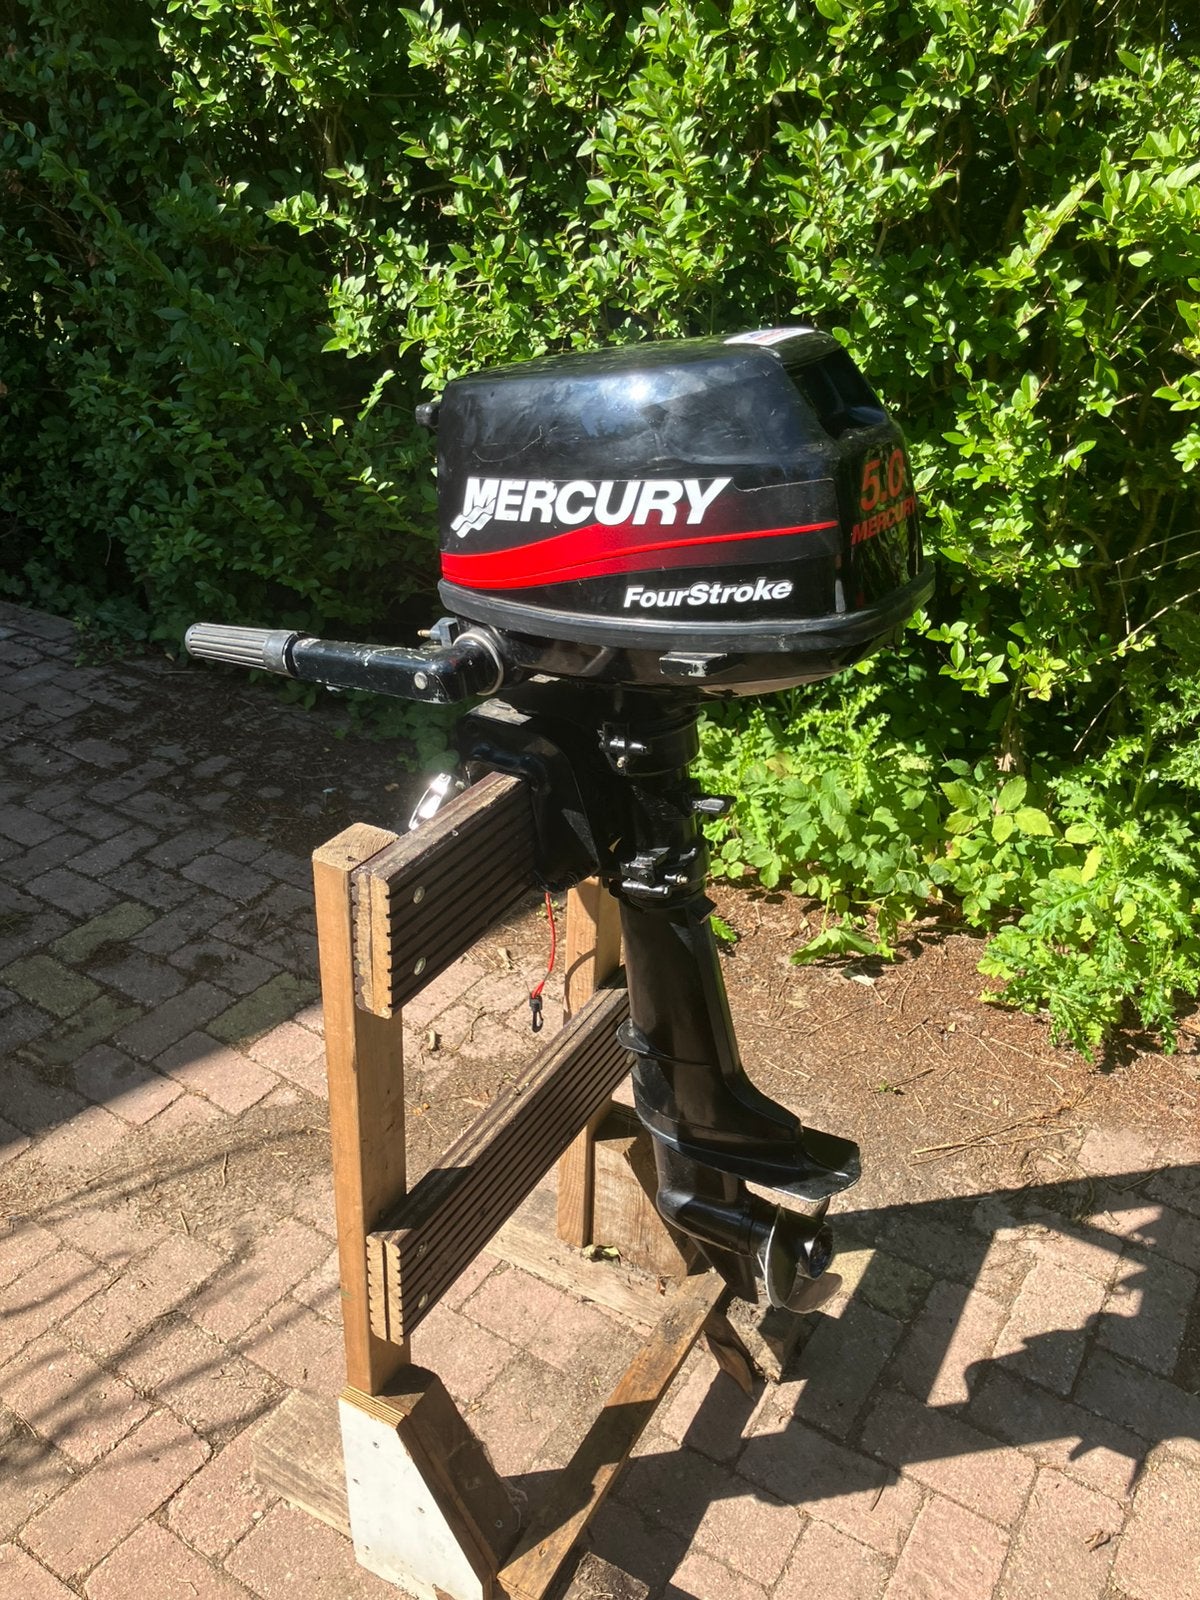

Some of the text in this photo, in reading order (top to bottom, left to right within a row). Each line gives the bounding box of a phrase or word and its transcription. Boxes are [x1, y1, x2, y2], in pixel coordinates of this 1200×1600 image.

[451, 476, 732, 538] MERCURY
[860, 448, 904, 512] 5.0
[623, 577, 793, 608] FourStroke
